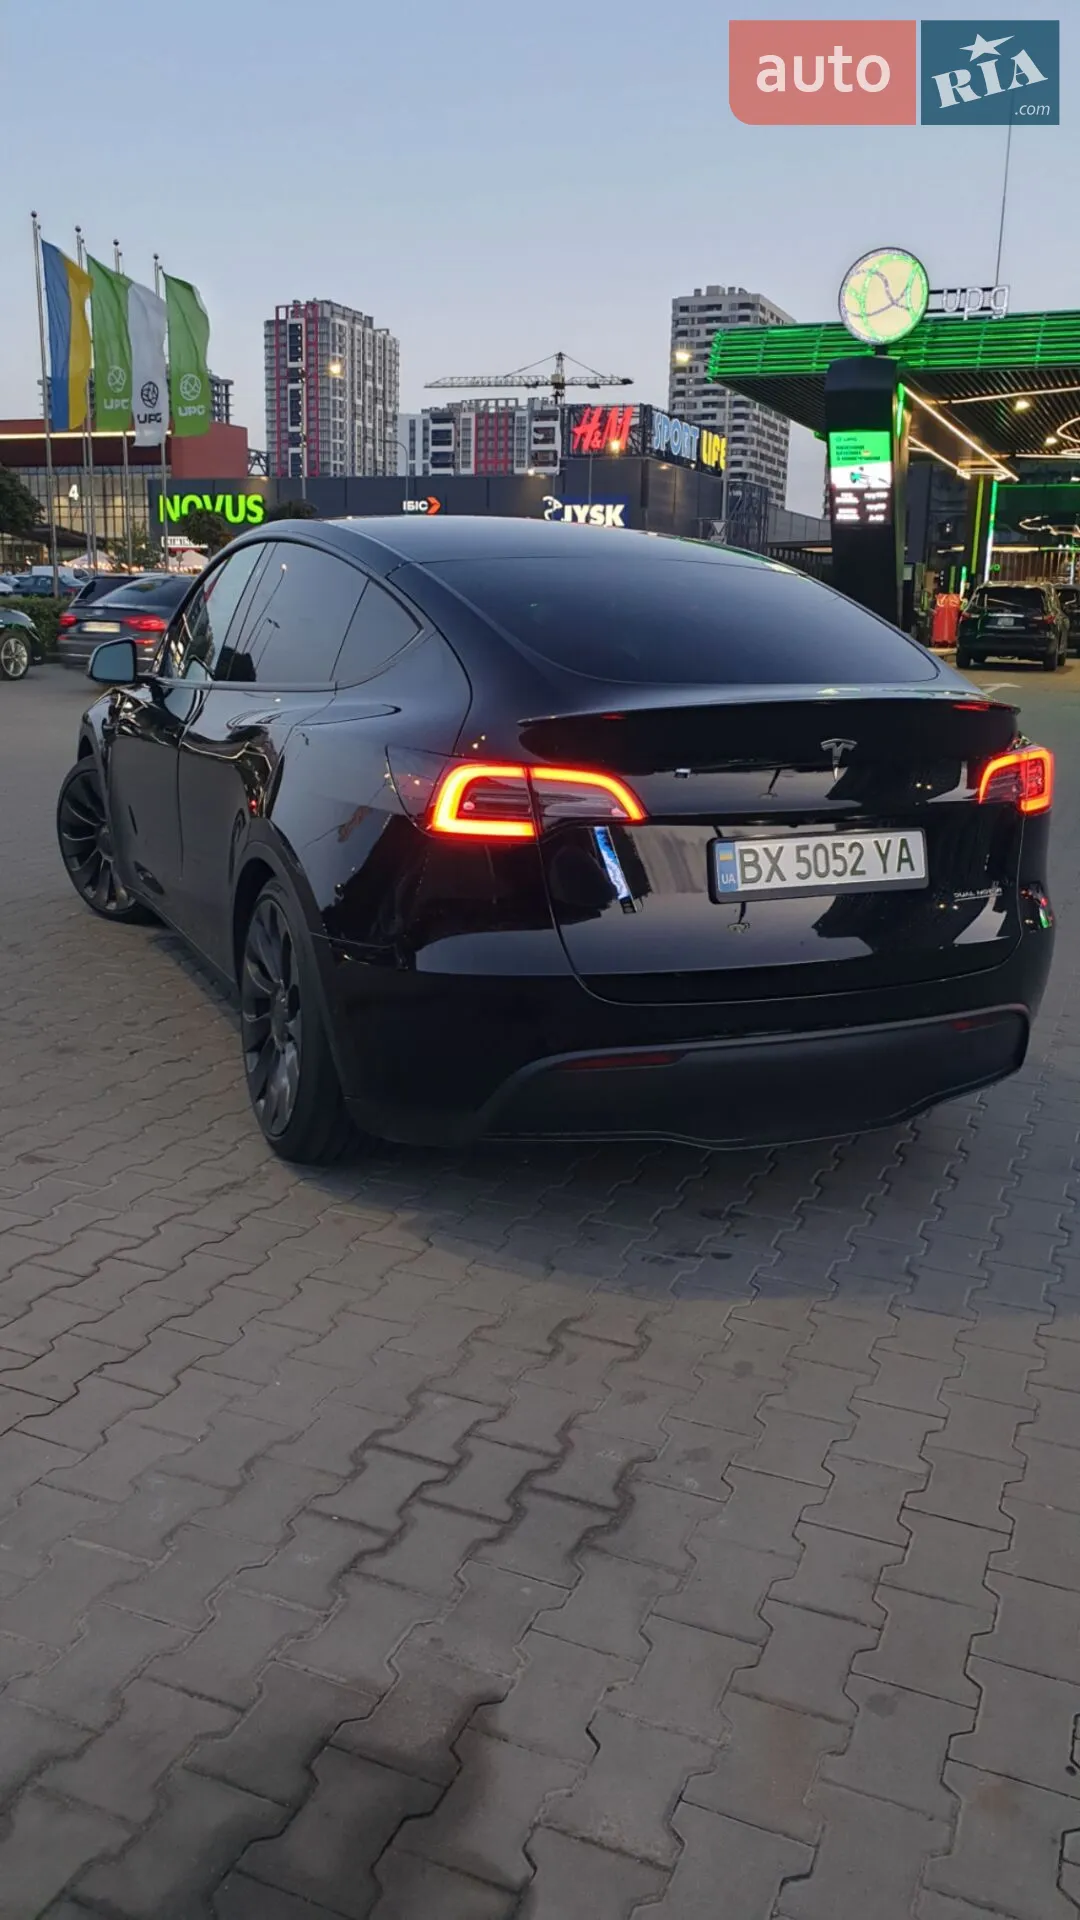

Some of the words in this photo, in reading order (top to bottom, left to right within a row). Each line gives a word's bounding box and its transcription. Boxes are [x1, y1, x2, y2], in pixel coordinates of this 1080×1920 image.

[943, 285, 1009, 320] upg
[573, 405, 634, 453] H&M
[653, 412, 700, 462] SPORT
[68, 484, 80, 500] 4
[159, 494, 265, 524] NOVUS
[560, 504, 625, 527] JYSK
[738, 846, 787, 884] BX
[795, 841, 867, 880] 5052
[873, 837, 915, 874] YA
[721, 874, 736, 884] UA
